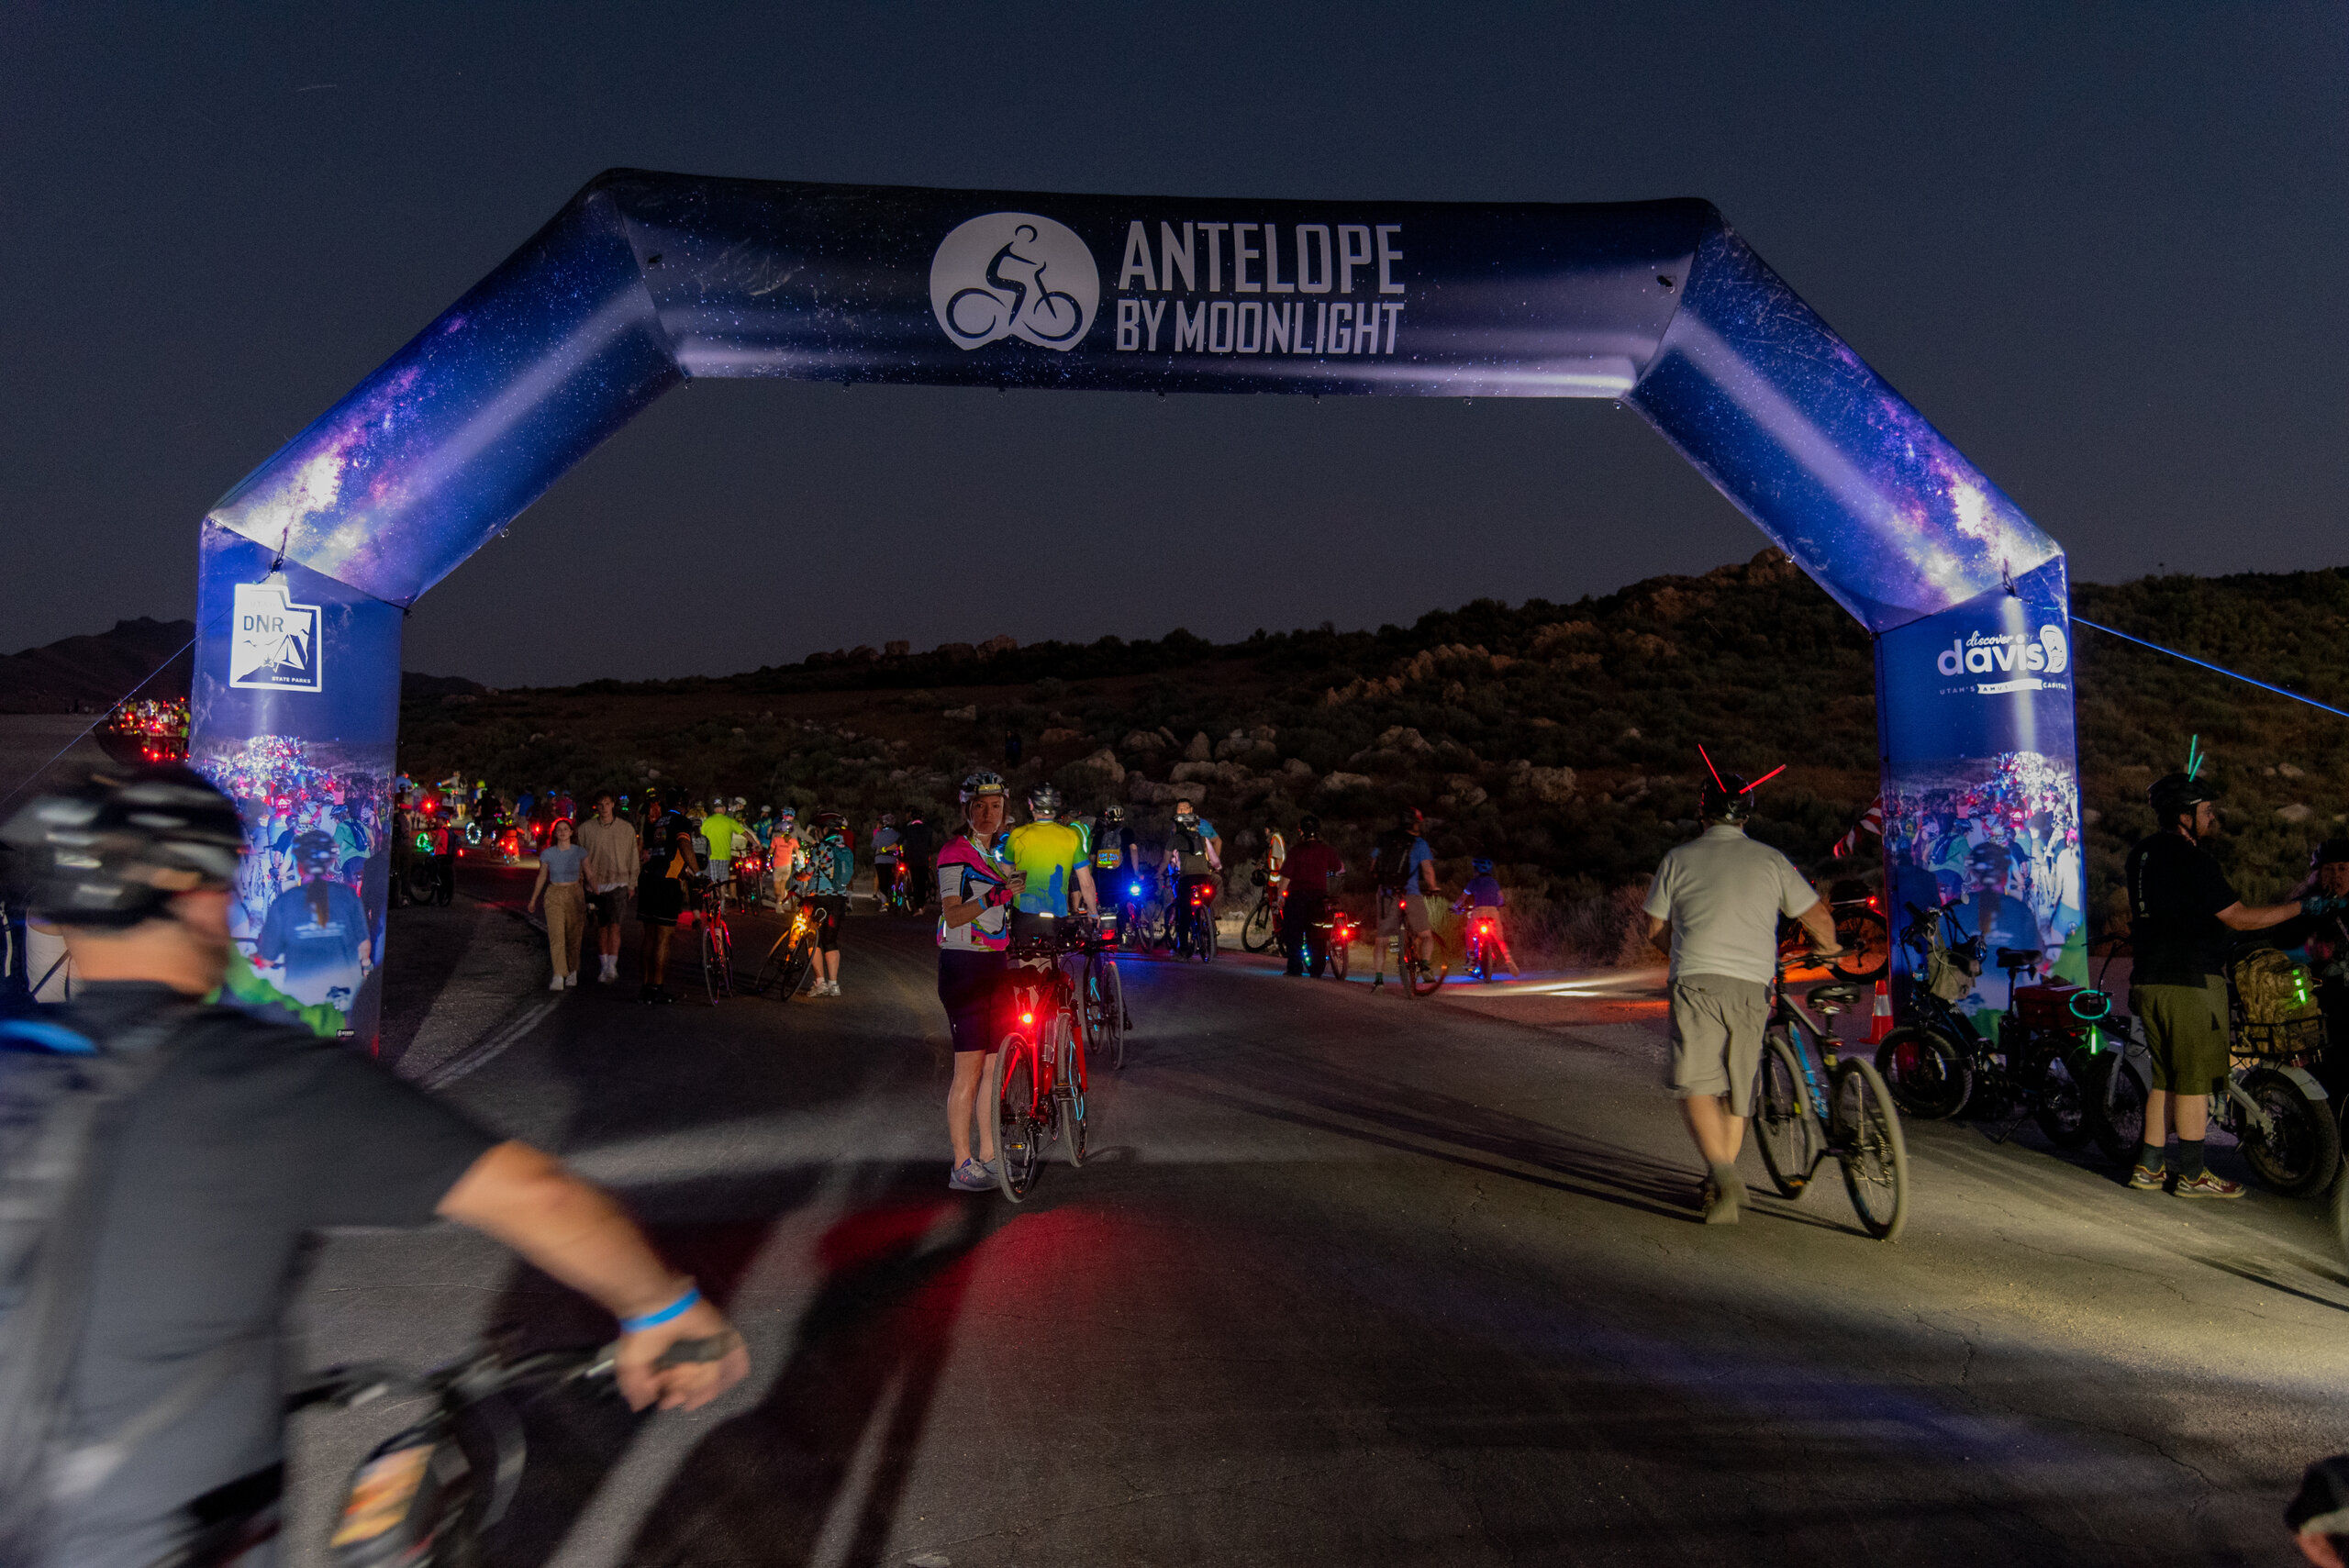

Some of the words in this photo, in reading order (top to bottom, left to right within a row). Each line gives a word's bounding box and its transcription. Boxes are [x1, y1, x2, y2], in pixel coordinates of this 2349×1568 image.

[1119, 221, 1405, 294] ANTELOPE
[1116, 299, 1164, 351] BY
[1174, 301, 1405, 354] MOONLIGHT
[243, 614, 284, 632] DNR
[1965, 629, 2013, 646] discover
[1937, 634, 2044, 675] davis
[1939, 685, 1975, 695] UTAH'S
